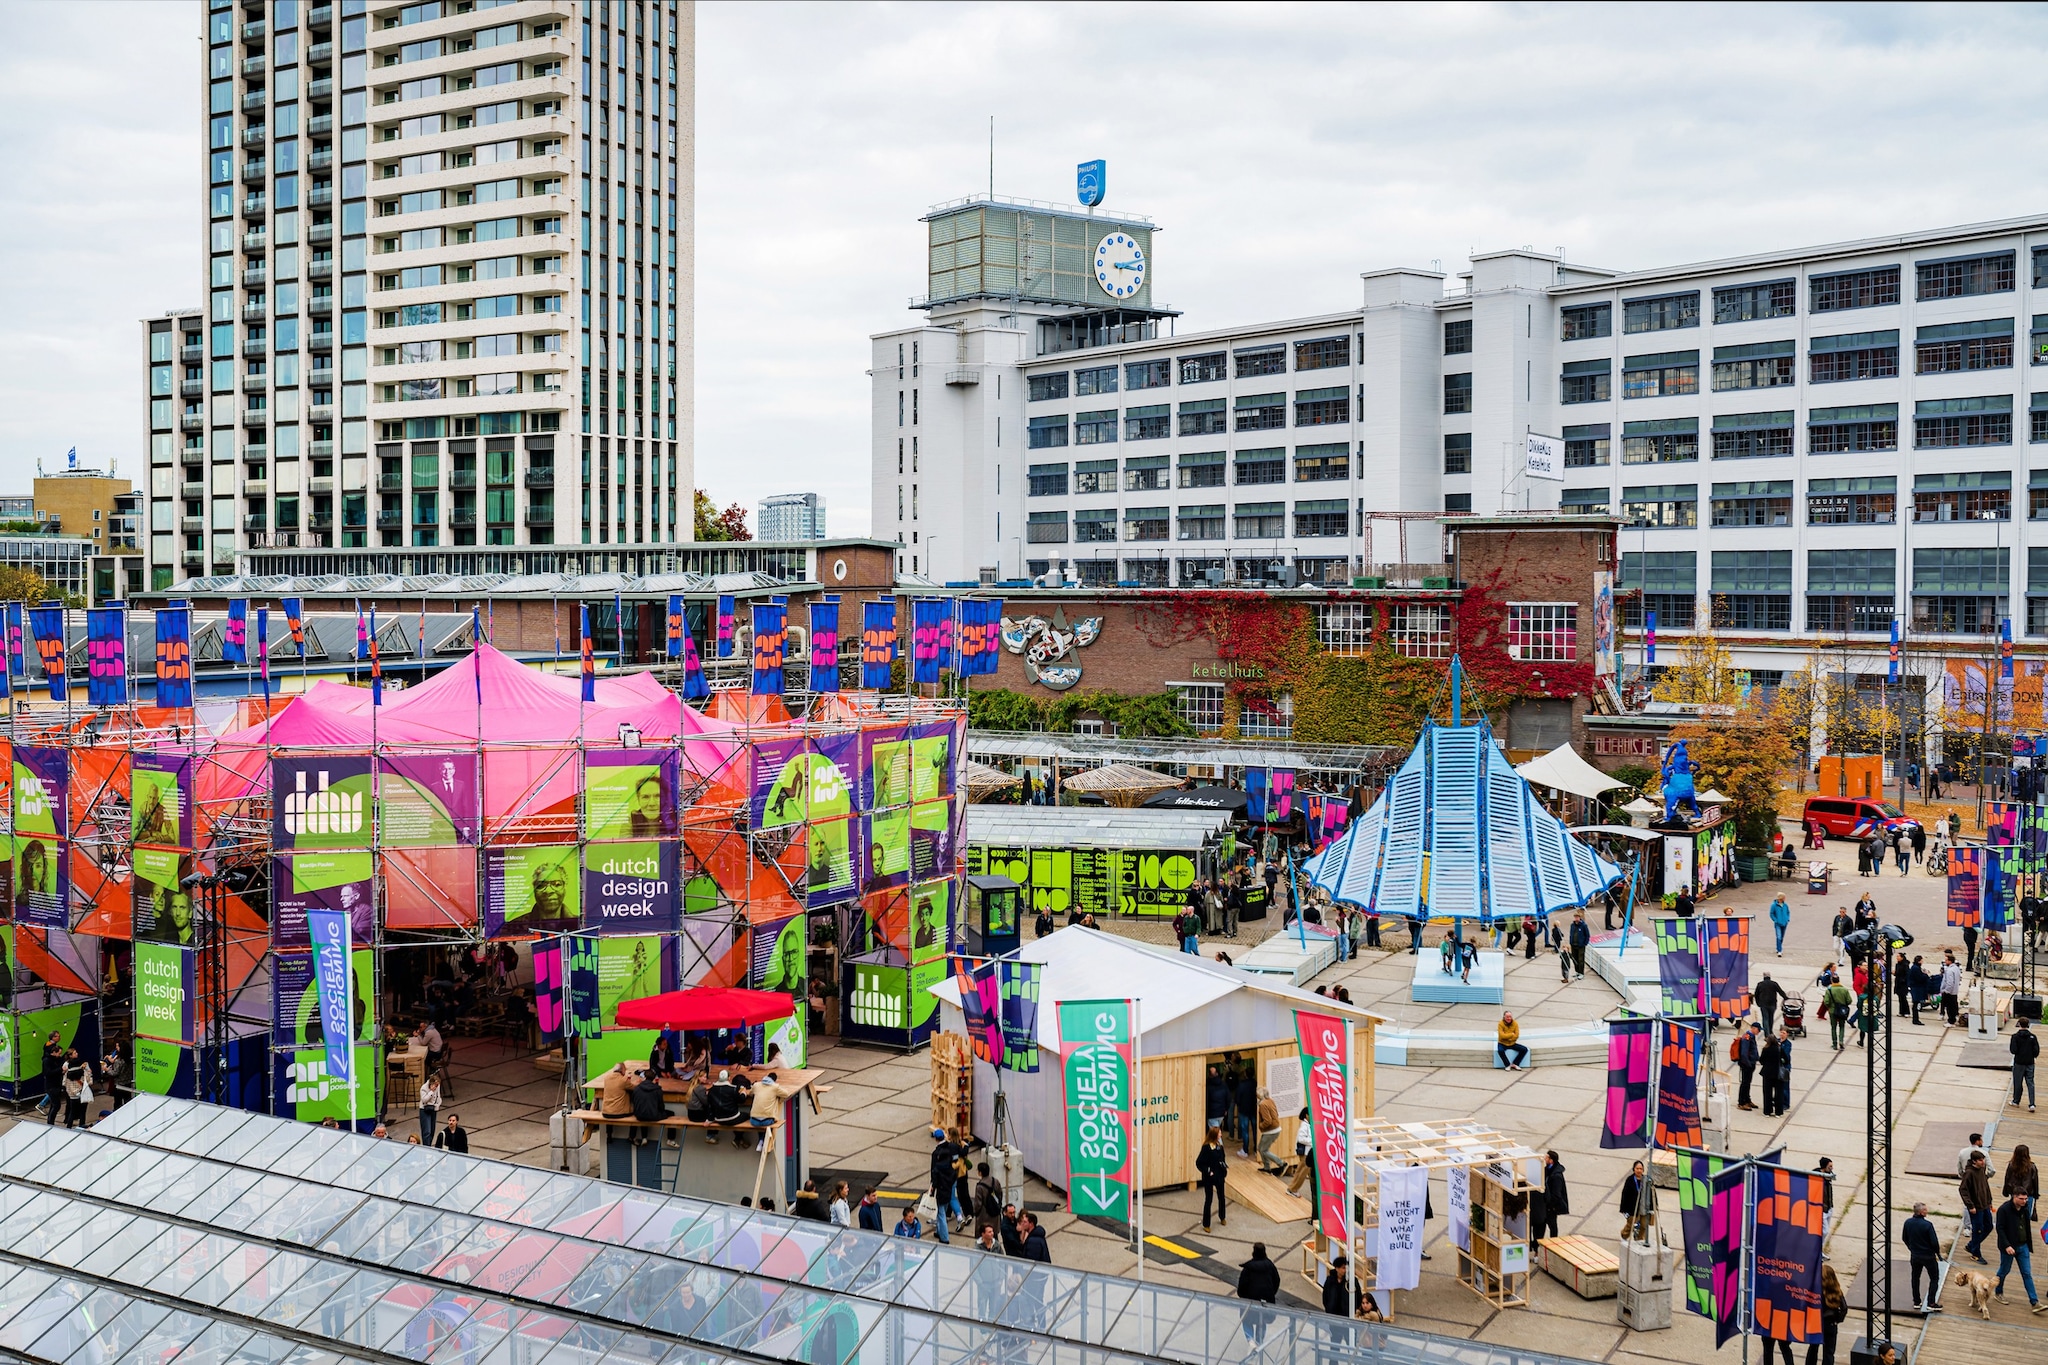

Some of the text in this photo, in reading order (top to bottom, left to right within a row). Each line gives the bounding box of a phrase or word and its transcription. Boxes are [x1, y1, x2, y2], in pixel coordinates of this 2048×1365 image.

[1078, 163, 1097, 174] PHILIPS
[1193, 662, 1264, 678] ketelhuis
[1174, 797, 1220, 807] fritz-kola
[602, 858, 657, 875] dutch
[602, 878, 668, 897] design
[602, 900, 654, 917] week
[144, 958, 178, 979] dutch
[144, 980, 185, 1002] design
[144, 1003, 176, 1022] week
[141, 1047, 153, 1056] DDW
[141, 1065, 158, 1074] Pavilion
[152, 1058, 169, 1068] Edition
[1151, 1095, 1168, 1105] are
[1149, 1112, 1179, 1125] alone
[1394, 1200, 1411, 1208] THE
[1386, 1208, 1420, 1217] WEIGHT
[1390, 1225, 1414, 1233] WHAT
[1396, 1233, 1410, 1241] WE
[1389, 1242, 1413, 1250] BUILD
[498, 1258, 547, 1283] DESIGNING
[1757, 1255, 1804, 1273] Designing
[505, 1269, 542, 1290] SOCIETY
[1757, 1266, 1793, 1281] Society
[1785, 1285, 1821, 1298] Dutch Design
